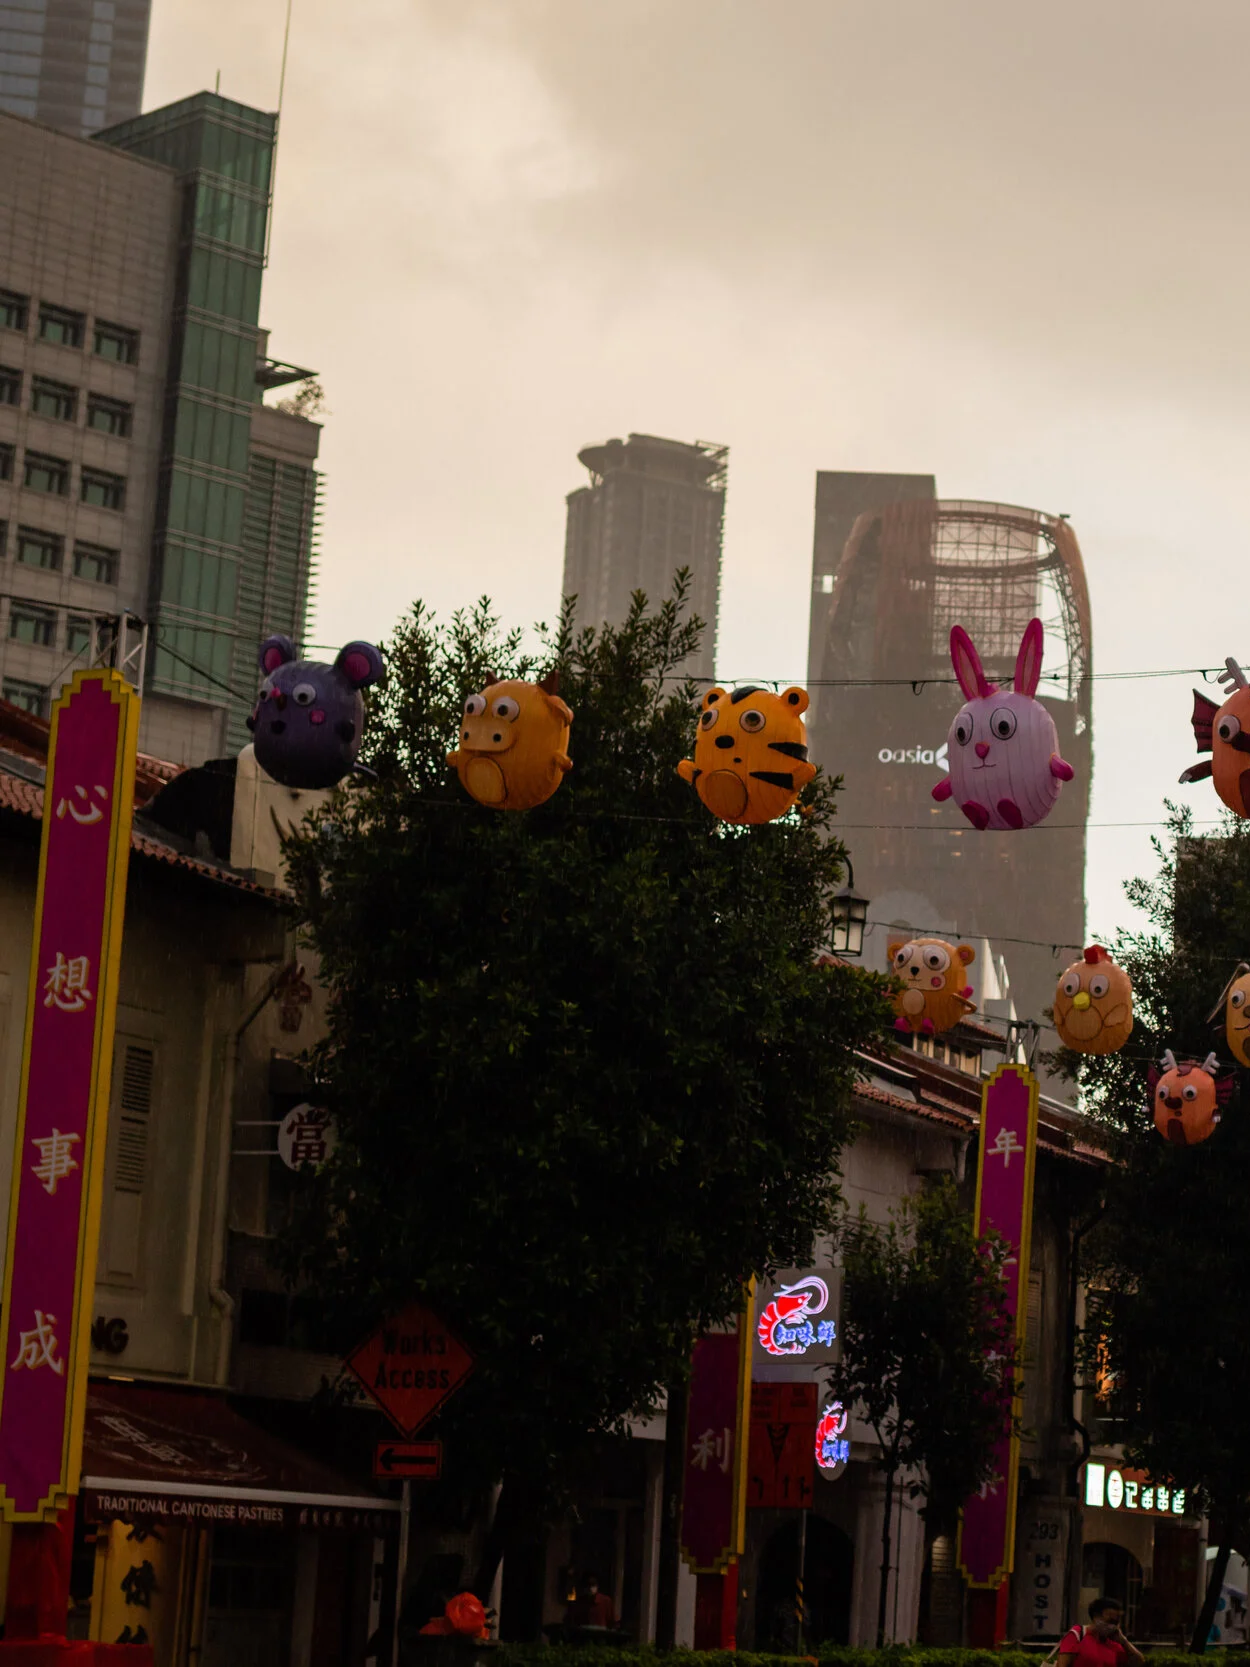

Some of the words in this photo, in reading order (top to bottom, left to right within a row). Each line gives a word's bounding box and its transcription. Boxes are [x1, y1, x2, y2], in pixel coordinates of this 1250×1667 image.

[878, 745, 934, 764] oasia
[9, 784, 108, 1374] 心想事成
[383, 1327, 447, 1355] Works
[374, 1361, 450, 1389] Access
[97, 1495, 169, 1515] TRADITIONAL
[171, 1501, 236, 1519] CANTONESE
[238, 1505, 284, 1521] PASTRIES
